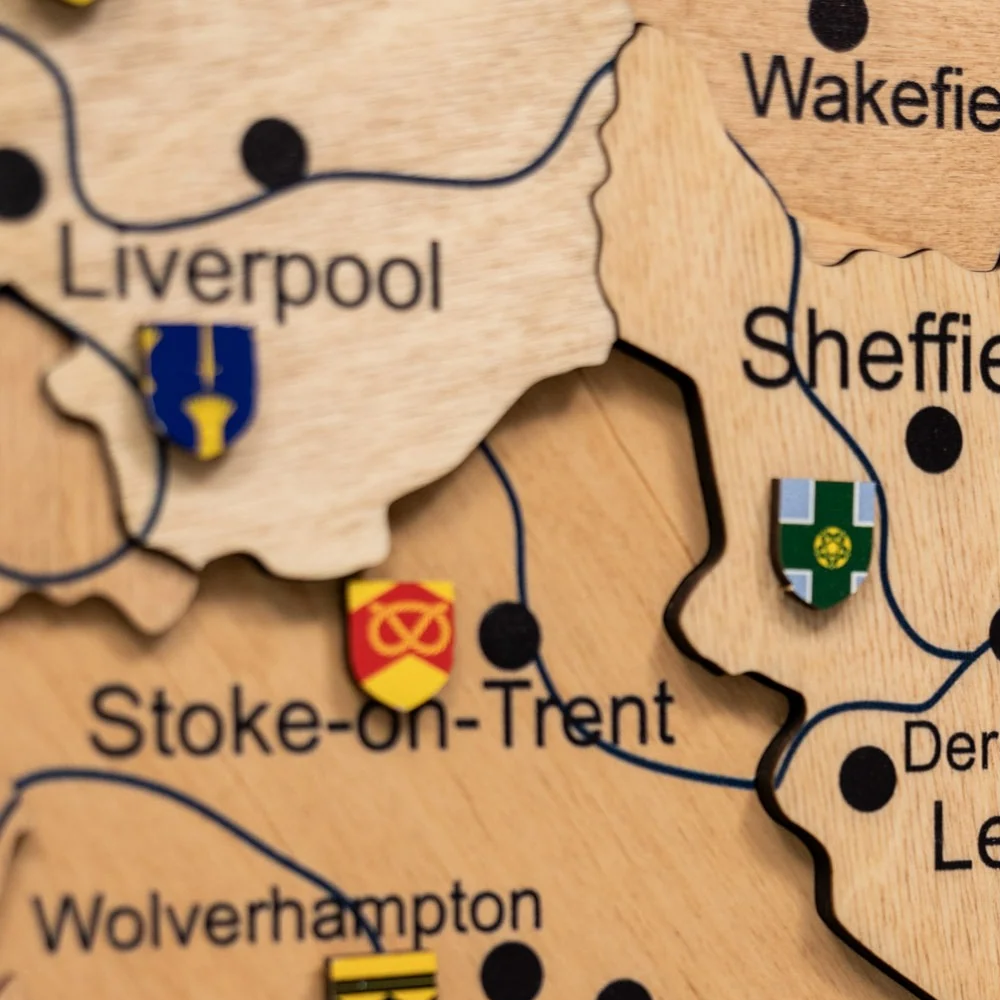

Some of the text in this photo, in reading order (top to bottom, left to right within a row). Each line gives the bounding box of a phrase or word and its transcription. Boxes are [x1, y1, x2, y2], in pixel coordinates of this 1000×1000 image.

[58, 222, 443, 325] Liverpool
[87, 680, 674, 758] Stoke-on-Trent
[32, 879, 544, 954] Wolverhampton
